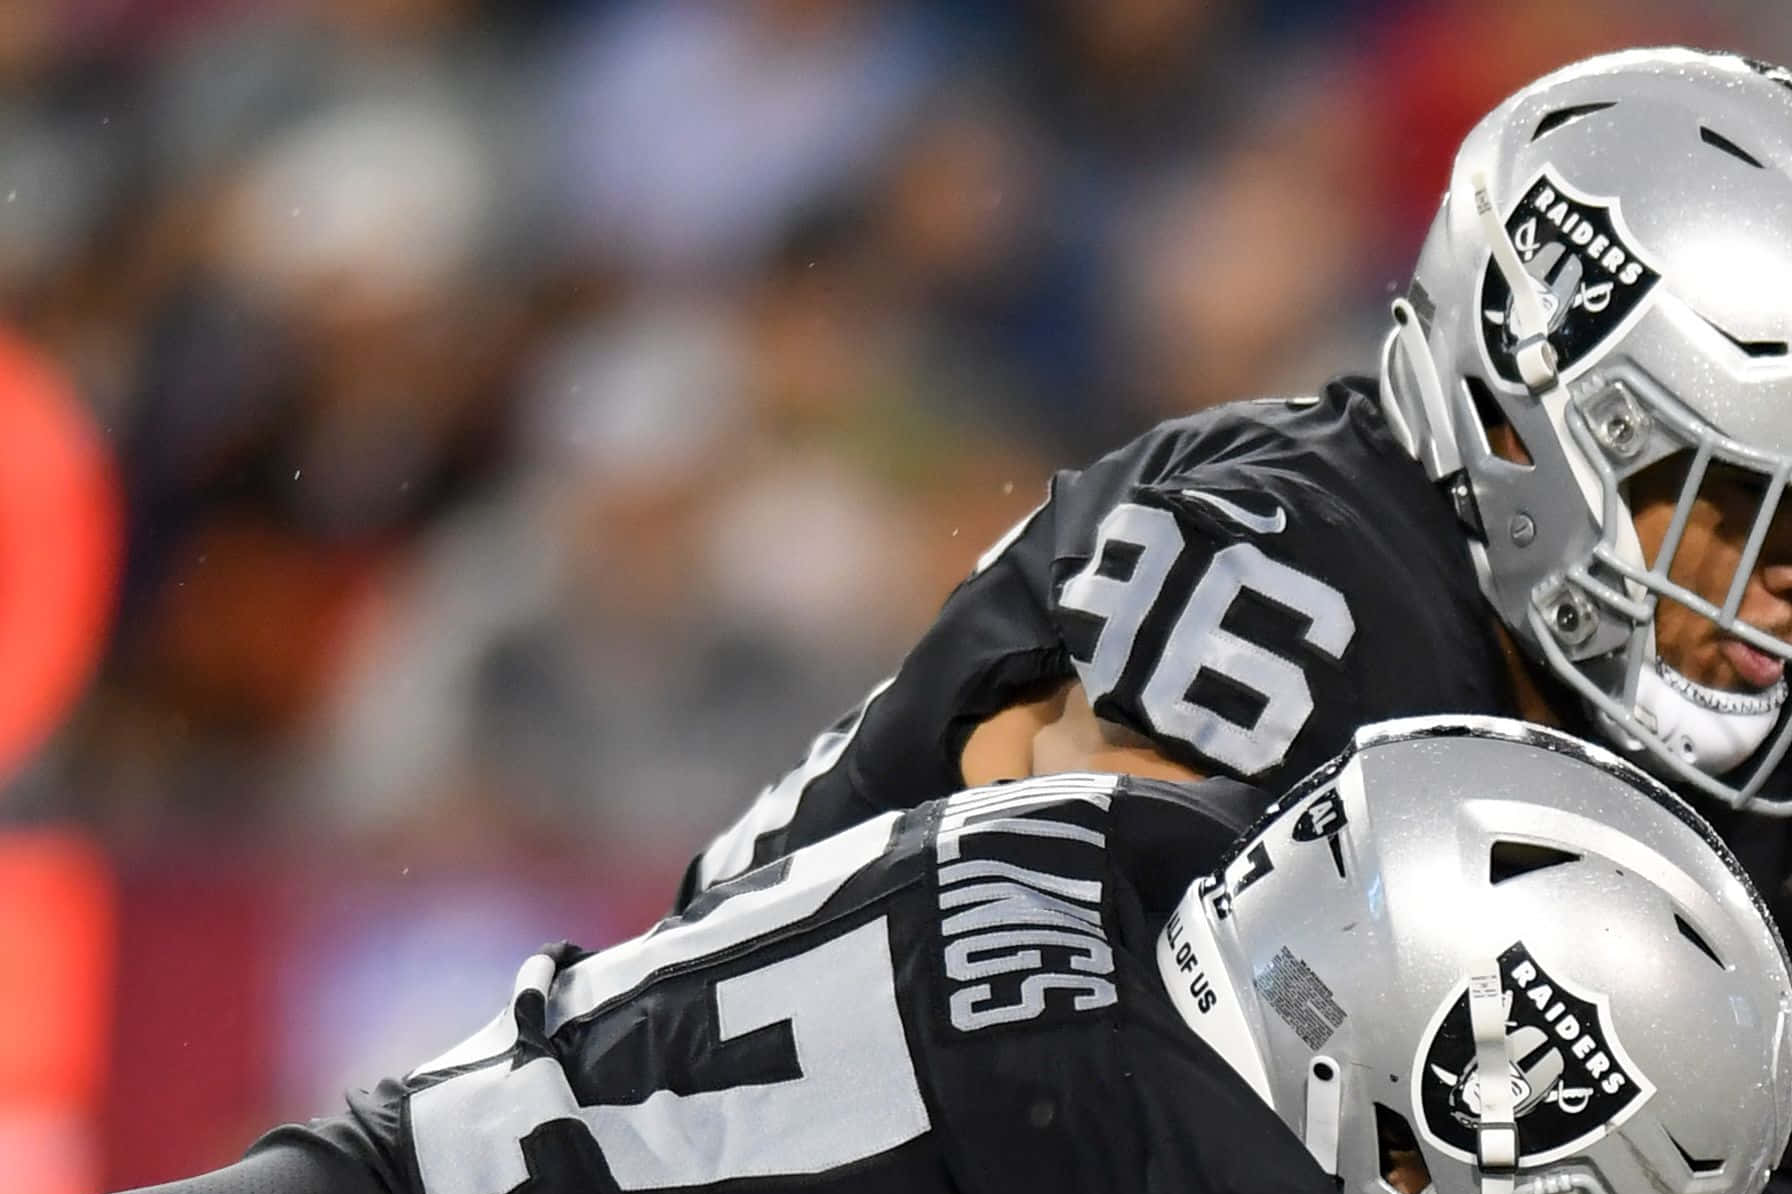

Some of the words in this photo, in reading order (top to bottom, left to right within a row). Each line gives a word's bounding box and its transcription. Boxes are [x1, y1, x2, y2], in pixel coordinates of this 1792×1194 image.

[1534, 186, 1643, 285] RAIDERS
[1057, 503, 1356, 775] 96
[1309, 800, 1338, 836] AL
[1176, 941, 1198, 974] OF
[1190, 972, 1217, 1014] US
[1511, 960, 1626, 1094] RAIDERS
